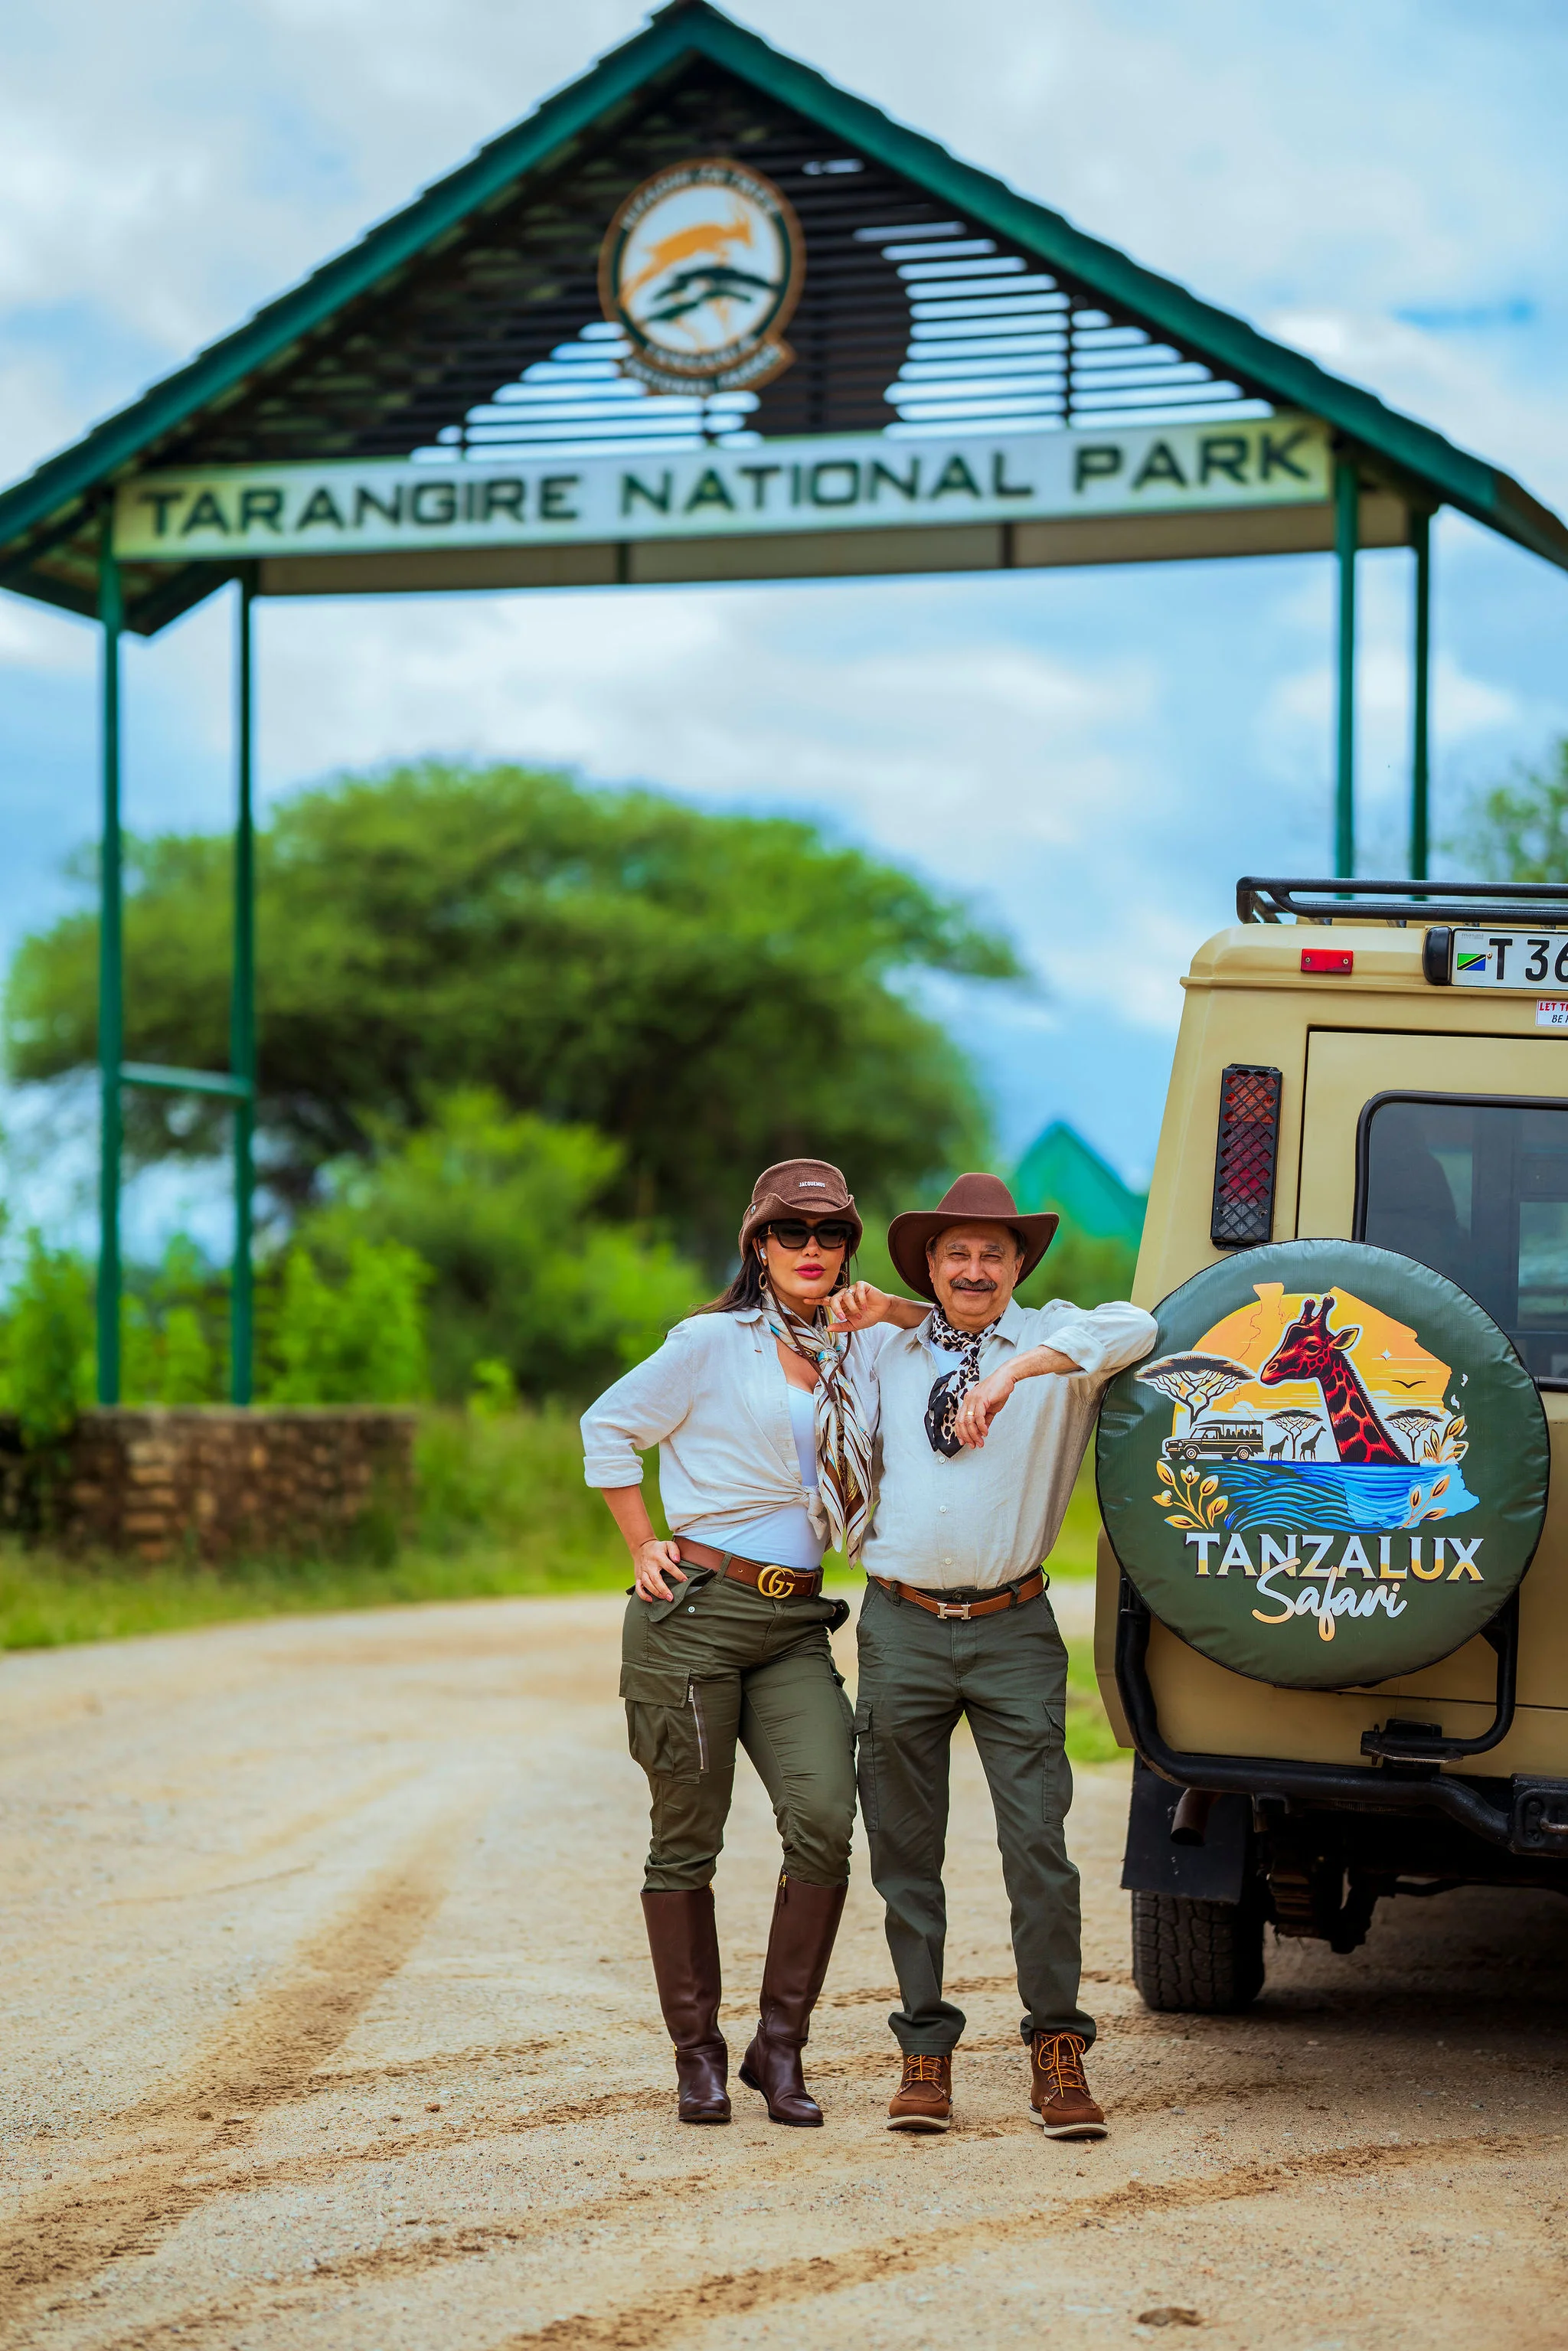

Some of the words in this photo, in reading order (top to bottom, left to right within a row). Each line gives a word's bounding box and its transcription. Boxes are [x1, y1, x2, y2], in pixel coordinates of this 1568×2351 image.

[141, 476, 582, 539] TARANGIRE
[621, 450, 1035, 516] NATIONAL
[1074, 429, 1312, 494] PARK
[1489, 939, 1513, 980] T
[1540, 1002, 1557, 1011] LET
[1551, 1014, 1563, 1024] BE
[1184, 1531, 1485, 1582] TANZALUX
[1251, 1557, 1409, 1641] Safari
